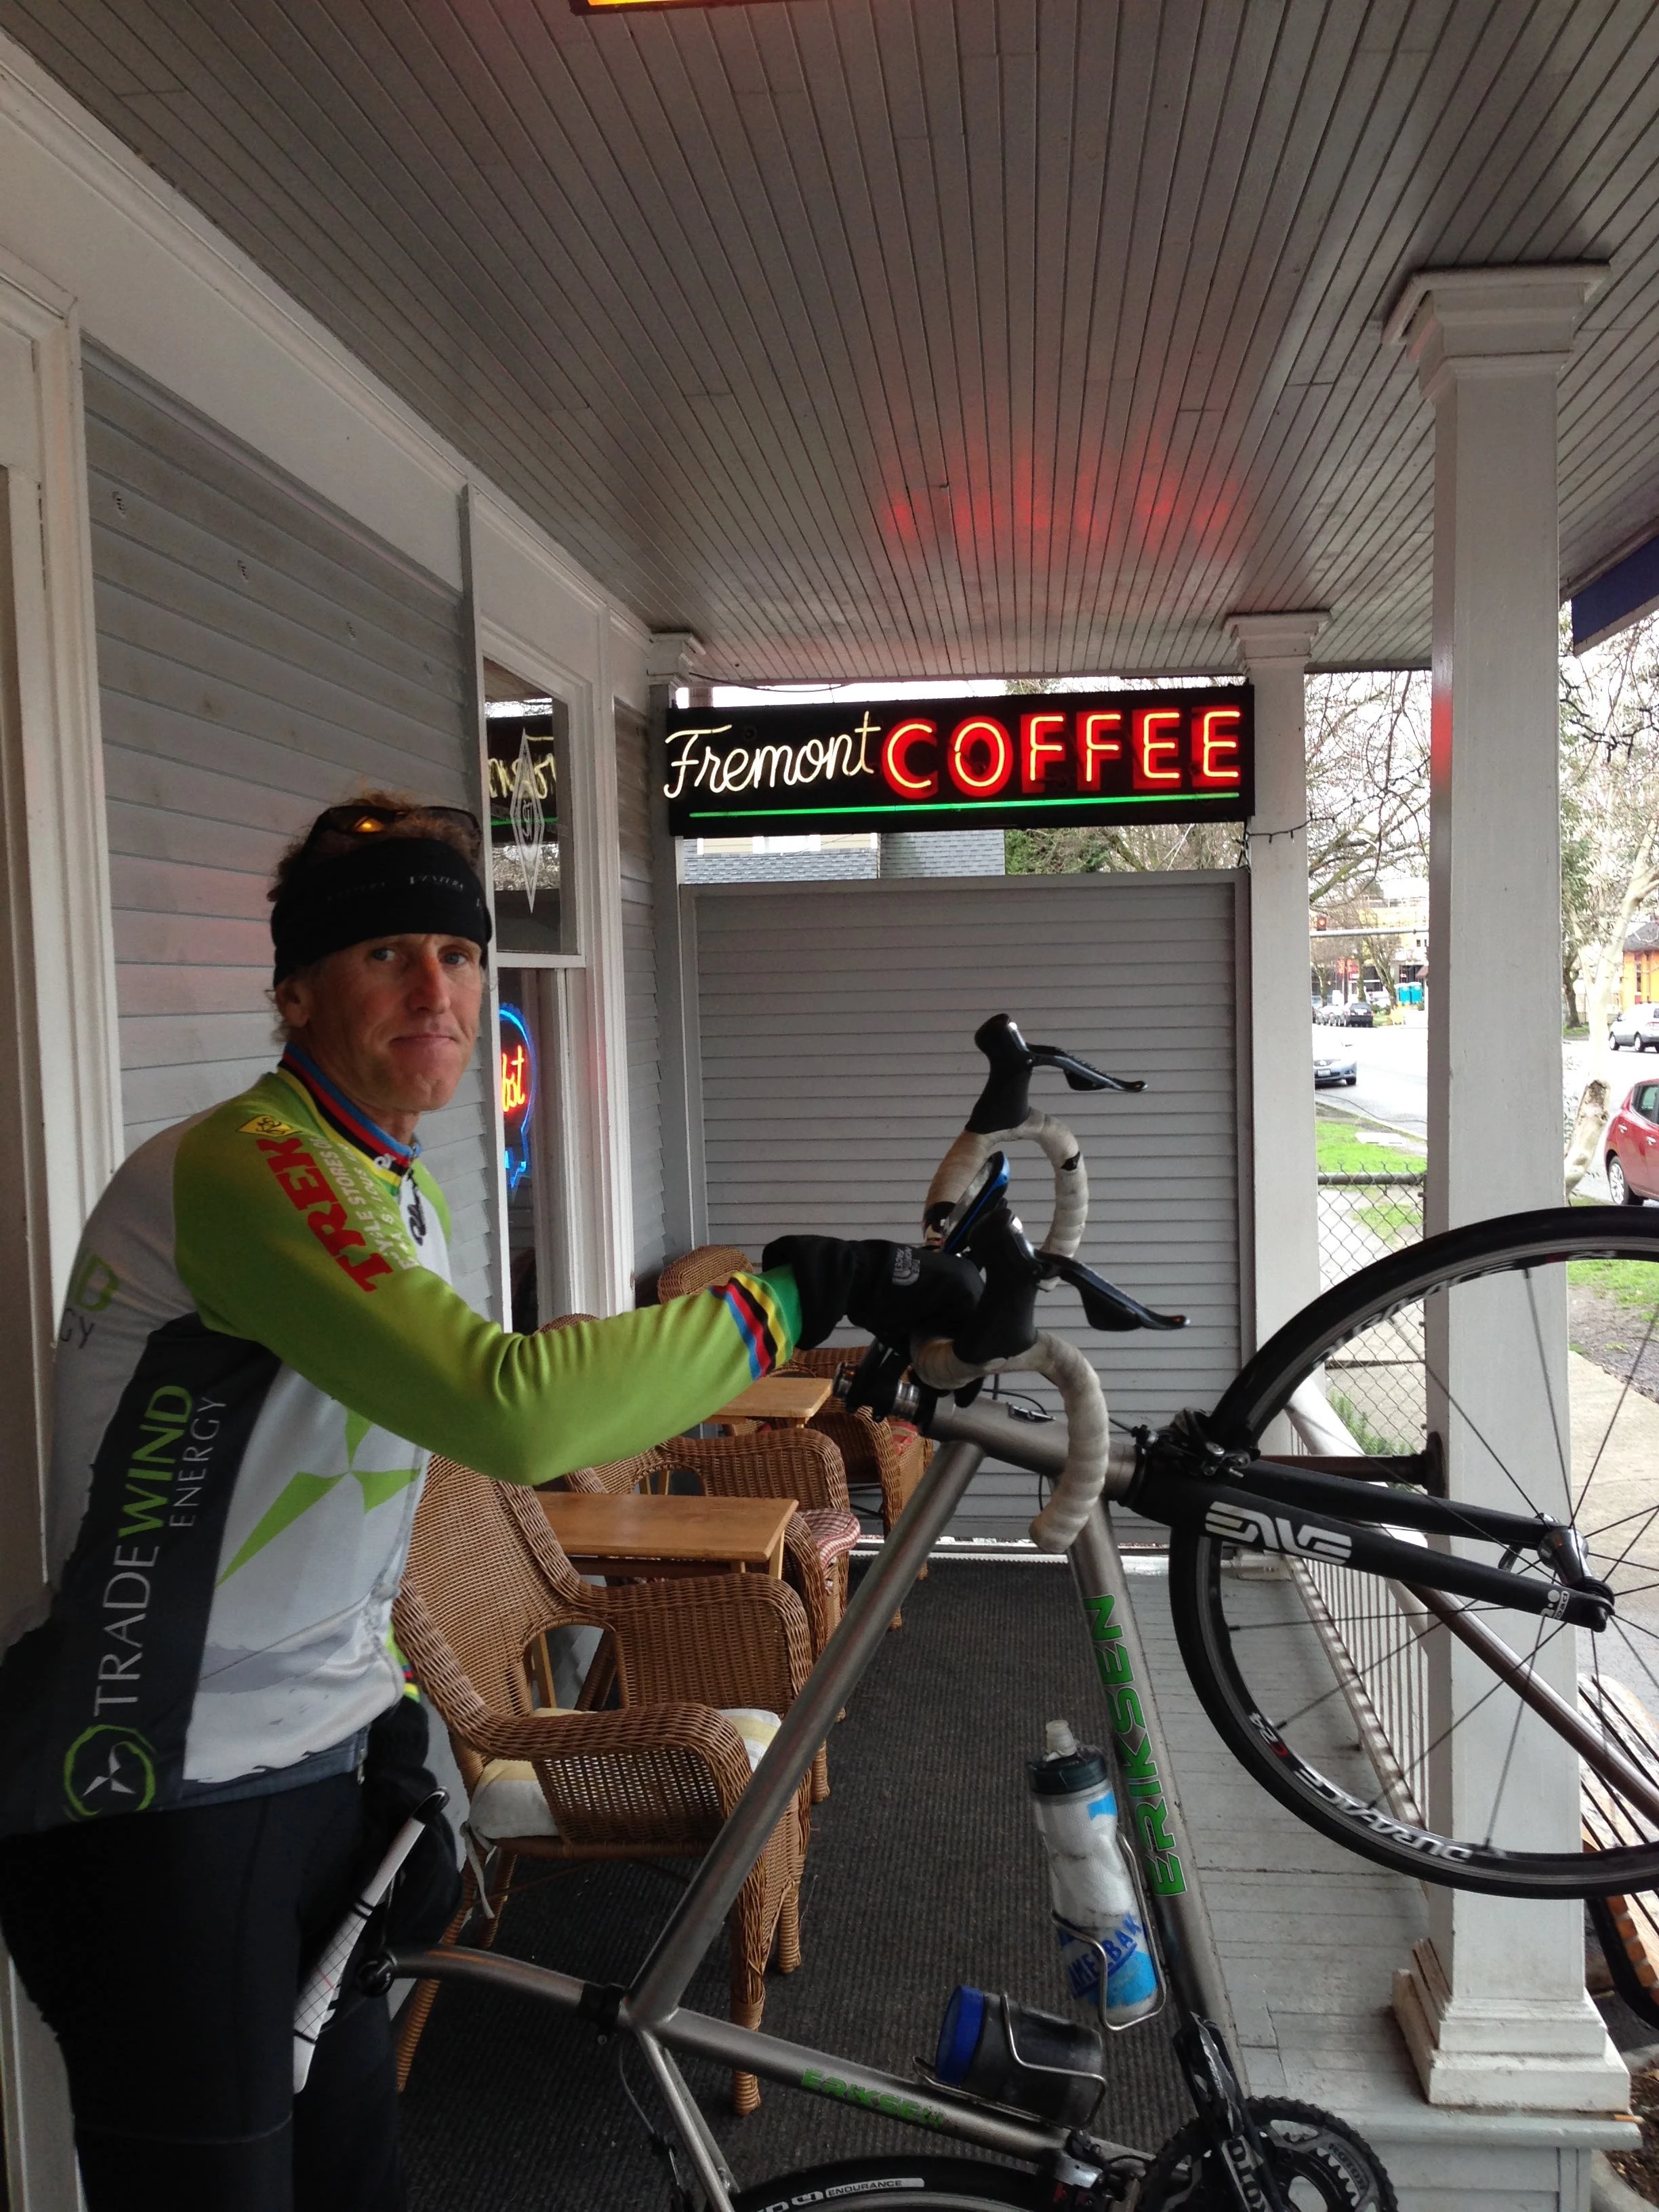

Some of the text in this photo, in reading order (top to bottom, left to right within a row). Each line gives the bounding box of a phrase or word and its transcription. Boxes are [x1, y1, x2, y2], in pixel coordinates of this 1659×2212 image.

[663, 711, 881, 799] Fremont
[882, 703, 1242, 799] COFFEE
[255, 1136, 394, 1293] TREK
[169, 1396, 227, 1528] ENERGY
[94, 1385, 194, 1717] TRADEWIND
[1084, 1593, 1187, 1898] ERIKSEN
[1249, 1712, 1475, 1862] DURA-ACE C24
[801, 2068, 945, 2126] ERIKSEN
[827, 2179, 903, 2198] ENDURANCE
